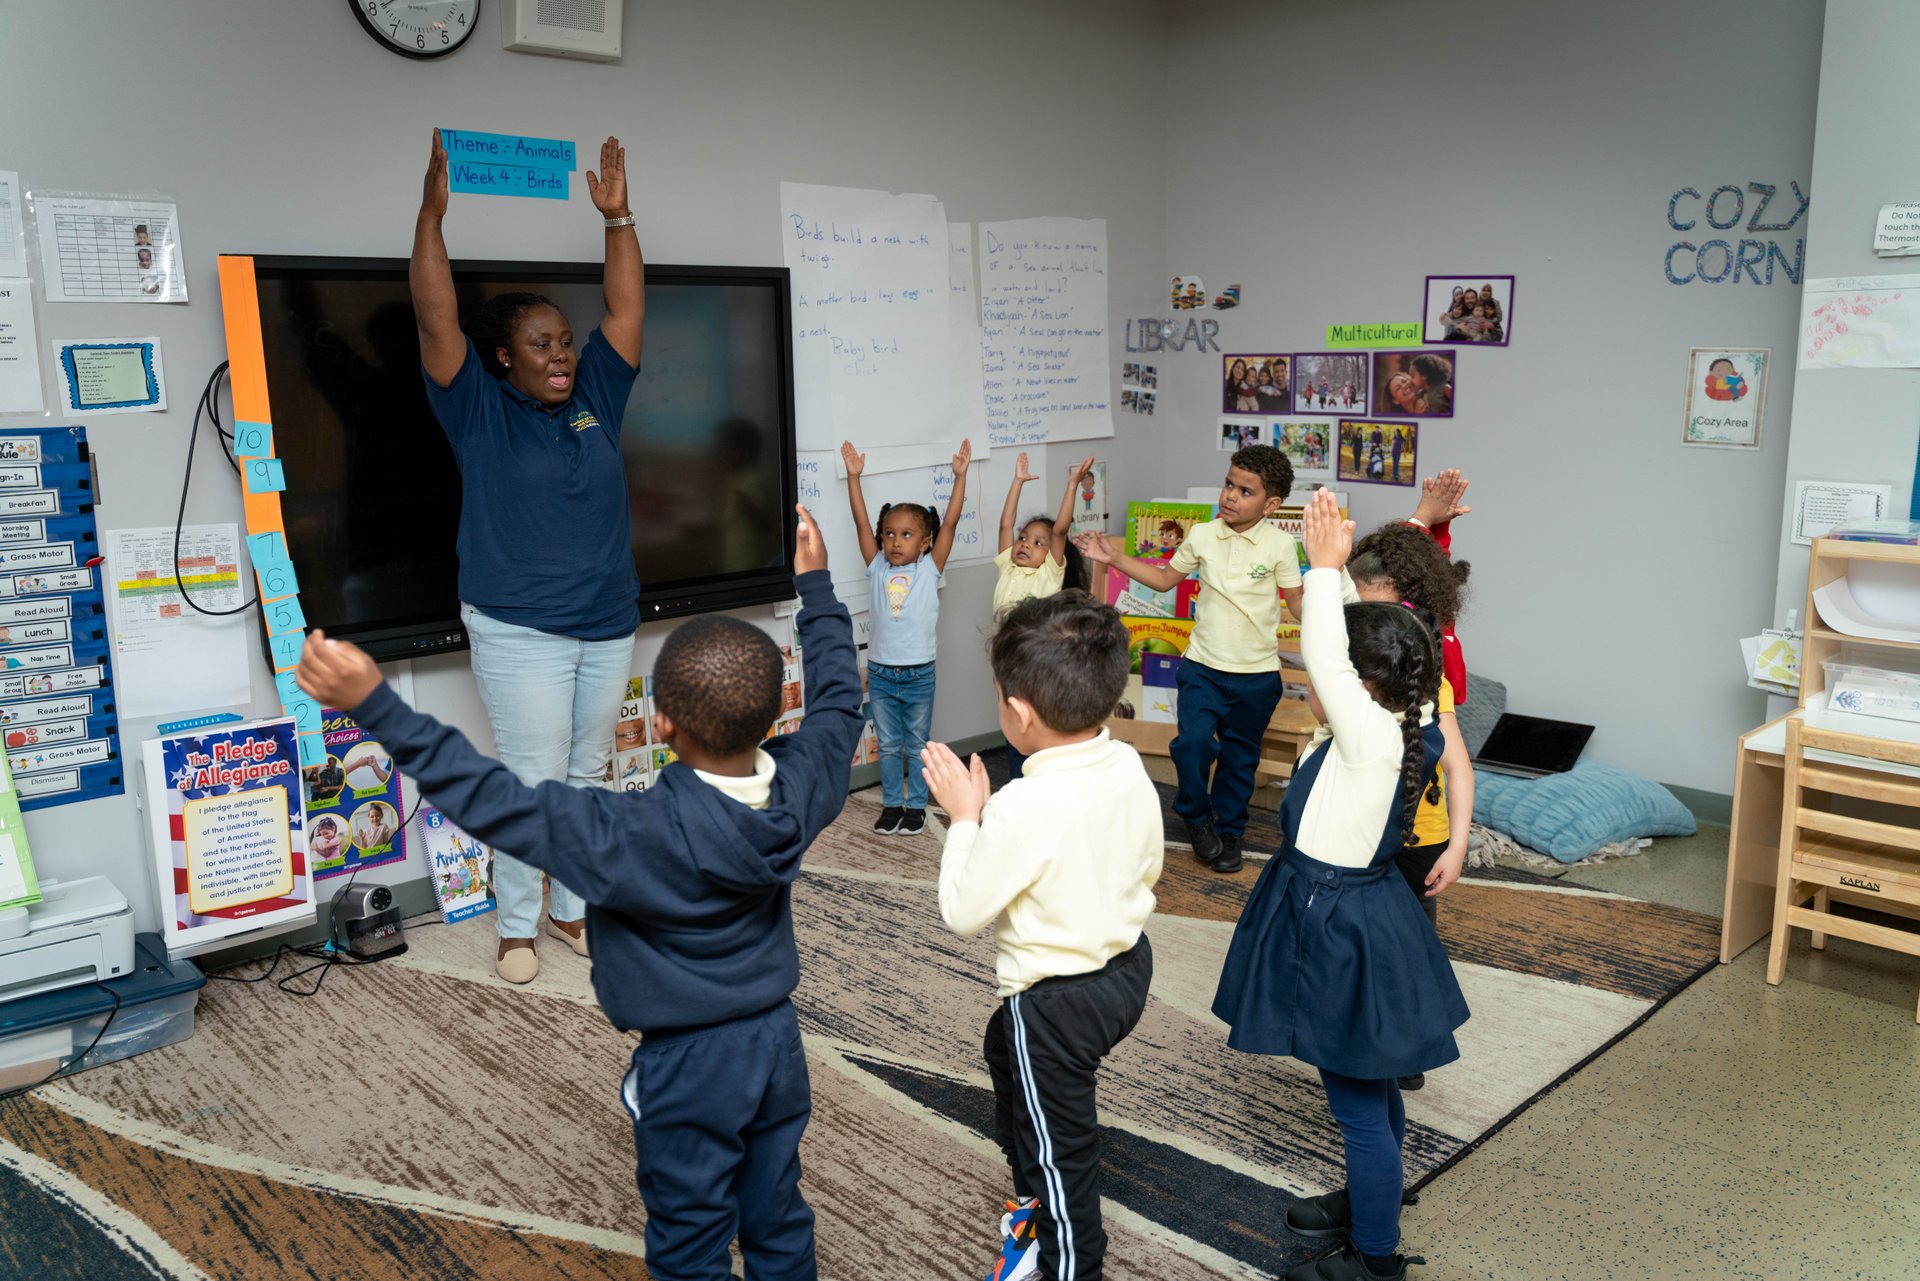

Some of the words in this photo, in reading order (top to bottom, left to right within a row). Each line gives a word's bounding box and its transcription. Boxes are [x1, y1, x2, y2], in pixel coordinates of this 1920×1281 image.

[368, 1, 378, 17] 8
[457, 12, 466, 27] 4
[389, 23, 398, 38] 7
[441, 30, 450, 45] 5
[416, 34, 425, 49] 6
[515, 138, 572, 162] Animals
[453, 164, 496, 186] Week
[527, 170, 563, 189] Birds
[1891, 211, 1904, 219] Do
[789, 214, 824, 241] Birds
[831, 222, 862, 245] build
[884, 234, 901, 245] nest
[1884, 223, 1909, 231] touch
[986, 230, 1004, 254] Do
[1331, 323, 1418, 342] Multicultural
[830, 336, 865, 362] Baby
[1695, 415, 1722, 429] Cozy
[1724, 417, 1749, 428] Area
[237, 428, 263, 450] 10
[0, 450, 19, 459] ule
[254, 461, 272, 487] 9
[933, 472, 956, 486] whal
[800, 478, 821, 498] fish
[8, 500, 47, 508] Breakfast
[1076, 512, 1100, 524] Library
[1, 525, 30, 533] Morning
[2, 531, 30, 539] Meeting
[256, 532, 275, 559] 7
[10, 551, 37, 561] Gross
[39, 550, 64, 558] Motor
[60, 573, 77, 581] Small
[265, 567, 286, 592] 6
[14, 608, 37, 617] Read
[38, 605, 64, 614] Aloud
[275, 603, 292, 629] 5
[24, 627, 53, 638] Lunch
[279, 638, 296, 662] 4
[30, 655, 44, 663] Nap
[45, 653, 61, 661] Time
[65, 679, 87, 687] Choice
[67, 672, 83, 680] Free
[37, 706, 59, 715] Read
[61, 703, 86, 712] Aloud
[293, 703, 309, 728] 2
[620, 703, 639, 718] Dd
[45, 725, 76, 736] Snack
[324, 731, 360, 745] Choices
[48, 750, 75, 760] Gross
[76, 745, 101, 755] Motor
[188, 753, 209, 767] The
[214, 738, 276, 761] Pledge
[31, 774, 66, 785] Dismissal
[179, 779, 191, 792] of
[196, 760, 289, 787] Allegiance
[203, 804, 232, 815] pledge
[233, 796, 274, 809] allegiance
[226, 821, 251, 832] United
[252, 817, 274, 827] States
[431, 816, 440, 828] 8
[202, 848, 219, 857] and
[229, 844, 242, 852] the
[244, 838, 277, 850] Republic
[435, 840, 483, 868] Animals
[218, 856, 242, 865] which
[197, 872, 213, 880] one
[215, 866, 241, 876] Nation
[242, 862, 264, 871] under
[243, 872, 259, 882] with
[259, 868, 283, 878] liberty
[1840, 875, 1880, 890] KAPLAN
[209, 890, 226, 899] and
[226, 886, 252, 897] justice
[451, 907, 474, 919] Teacher
[474, 902, 490, 912] Guide
